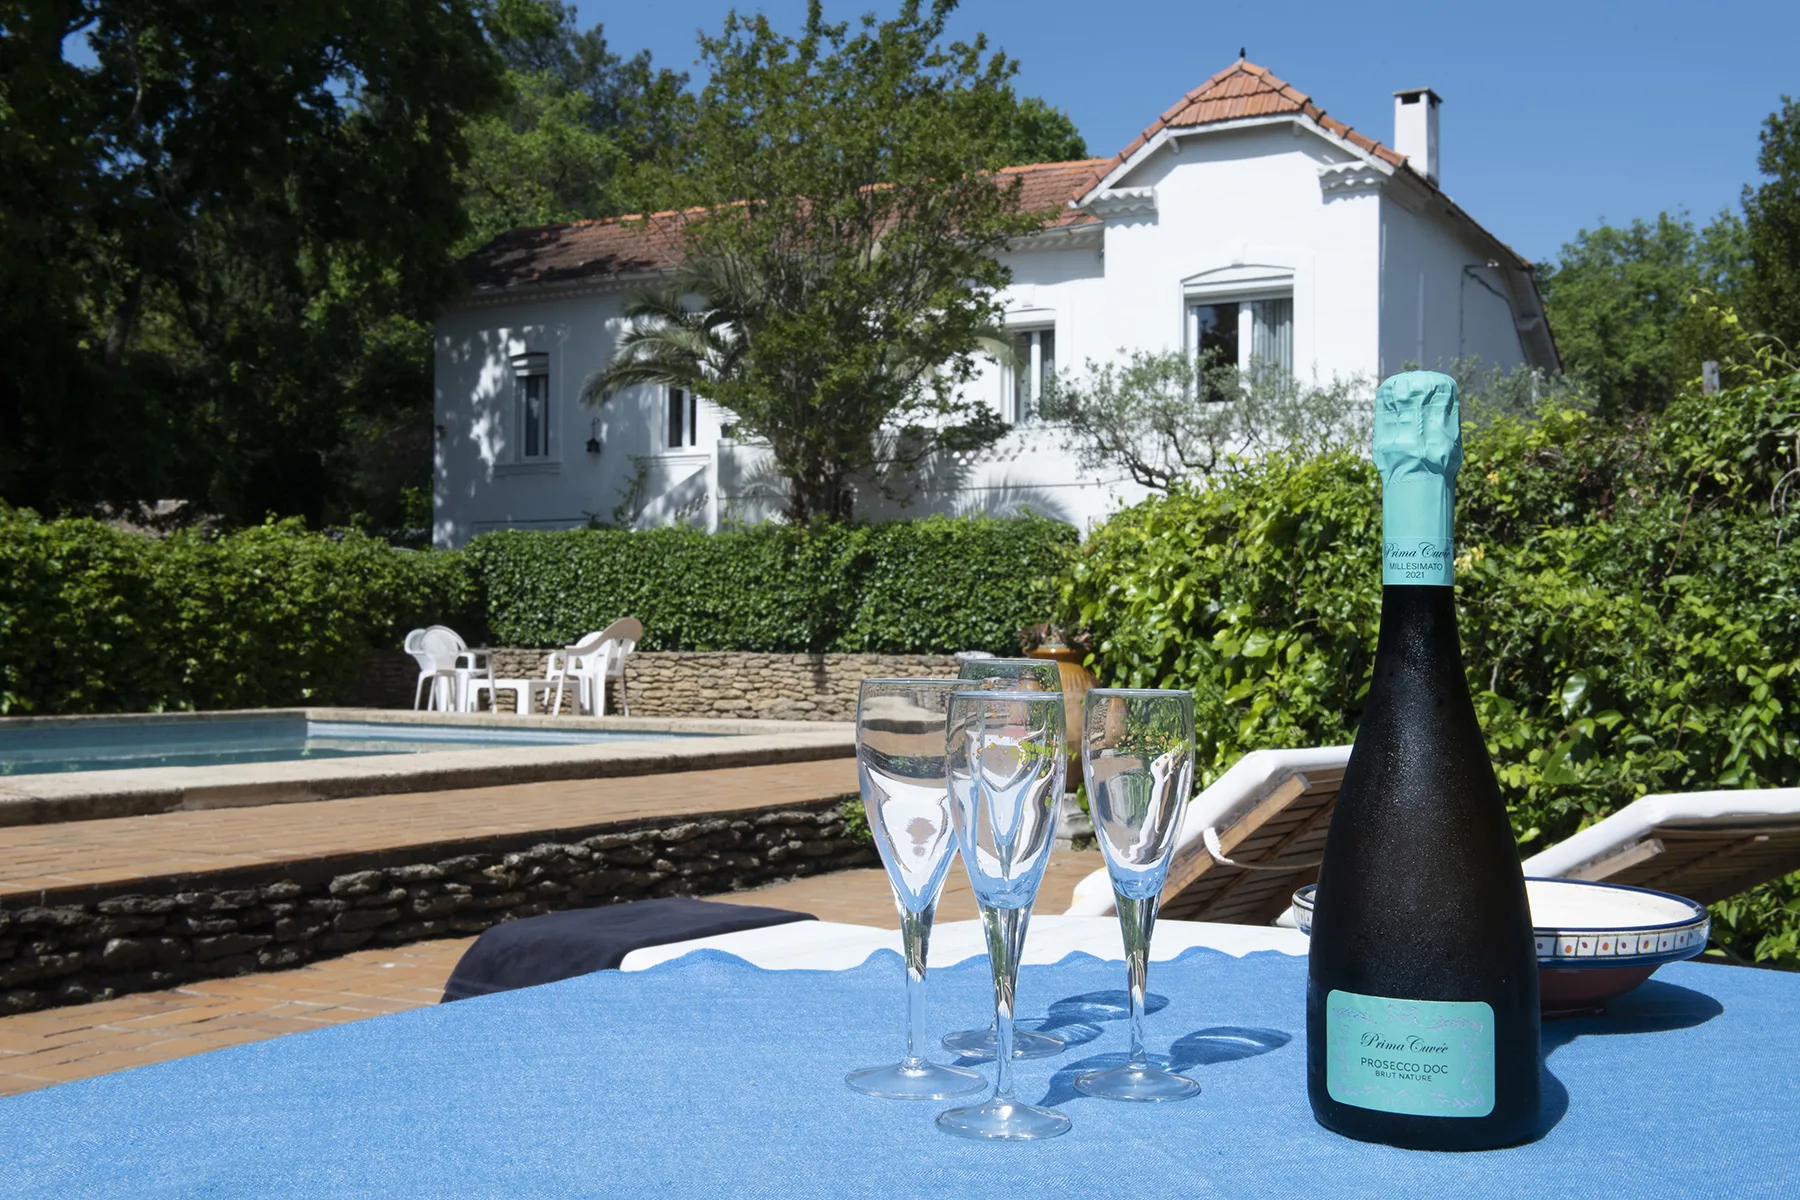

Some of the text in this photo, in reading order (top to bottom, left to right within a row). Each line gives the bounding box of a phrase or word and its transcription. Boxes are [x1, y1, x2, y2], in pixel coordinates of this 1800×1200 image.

[1384, 542, 1418, 558] Prima
[1389, 562, 1443, 571] MILLESIMATO
[1360, 1031, 1449, 1054] Prima Cuvée
[1360, 1057, 1449, 1074] PROSECCO DOC
[1375, 1070, 1432, 1082] BRUT NATURE
